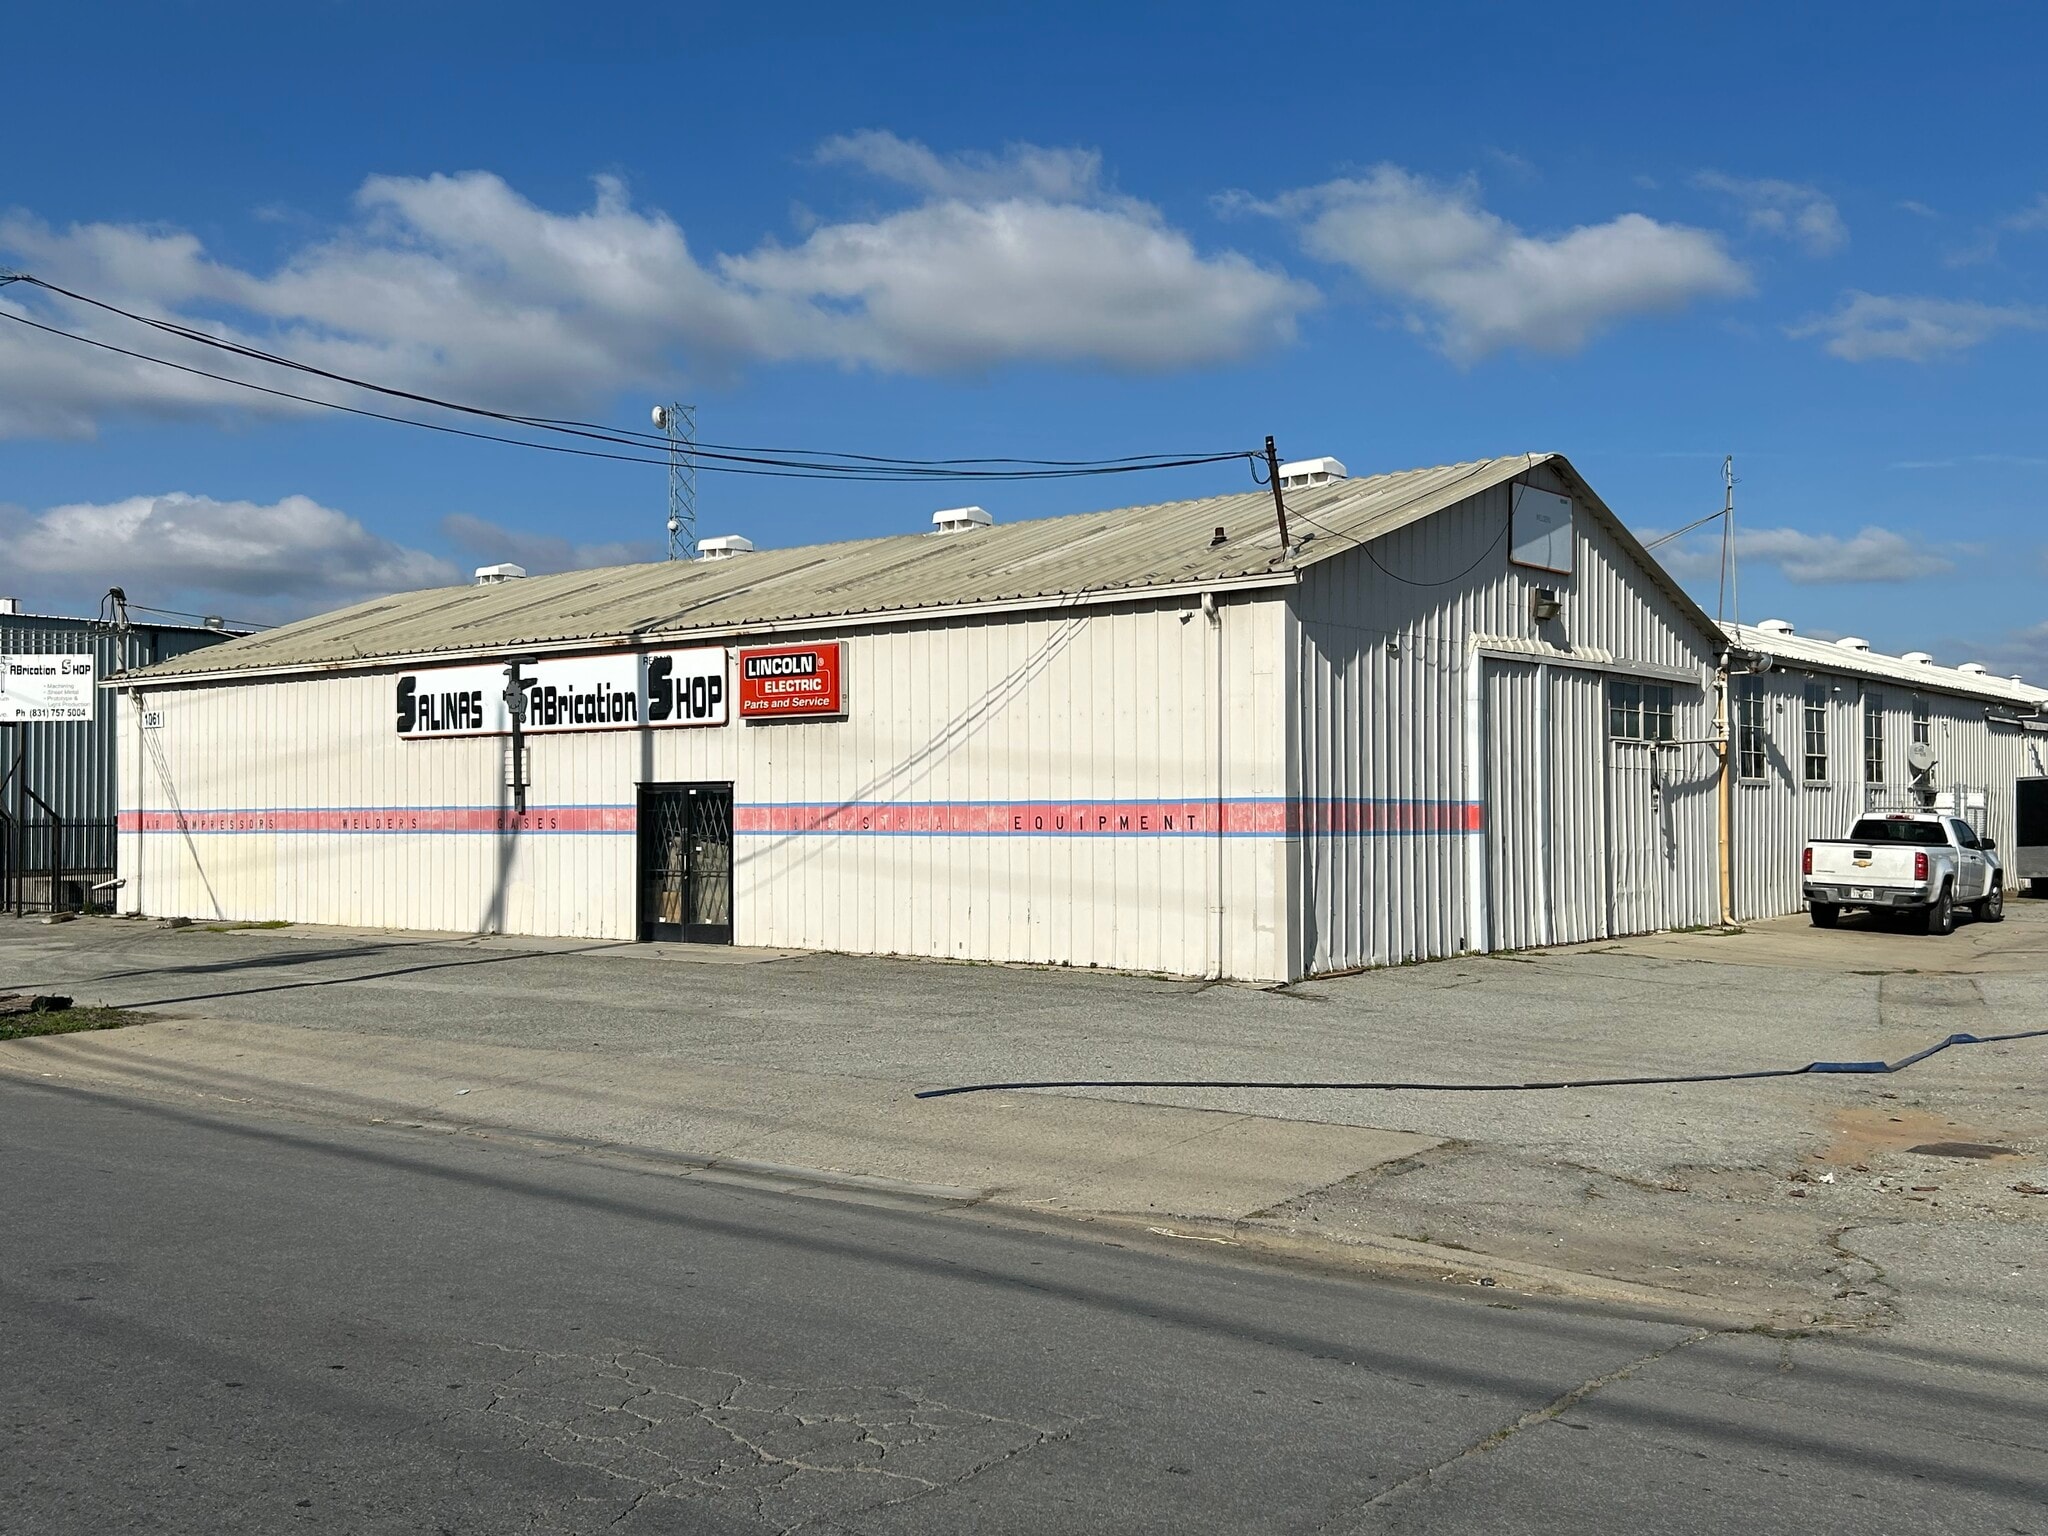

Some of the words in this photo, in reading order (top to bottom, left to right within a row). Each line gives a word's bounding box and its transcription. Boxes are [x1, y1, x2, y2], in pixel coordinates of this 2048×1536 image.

[748, 655, 813, 677] LINCOLN
[397, 676, 482, 732] SALINAS
[647, 656, 723, 720] SHOP
[764, 678, 822, 694] ELECTRIC
[743, 699, 769, 710] Parts
[771, 697, 790, 708] and
[792, 696, 830, 707] Service
[15, 708, 26, 717] Ph
[29, 708, 49, 719] (831)
[51, 708, 65, 717] 757
[67, 708, 86, 717] 5004
[144, 711, 161, 727] 1061
[342, 818, 417, 830] WELDERS
[496, 817, 557, 830] GASES
[1014, 814, 1197, 831] EQUIPMENT
